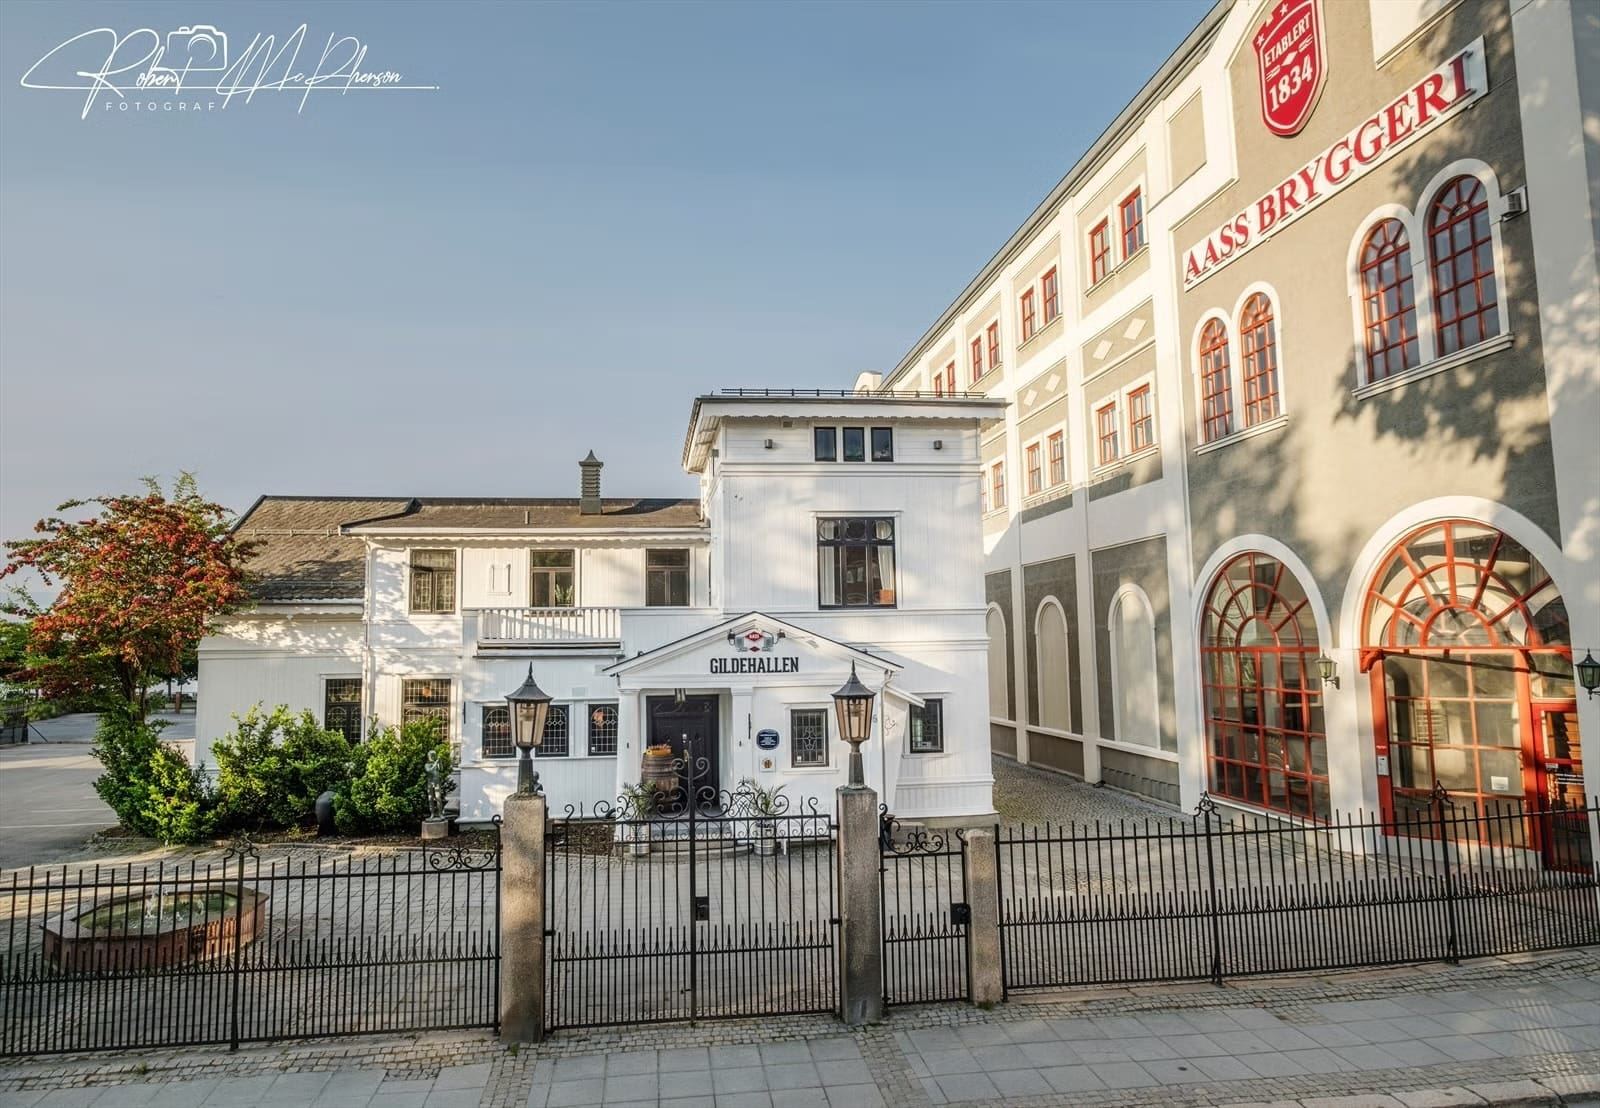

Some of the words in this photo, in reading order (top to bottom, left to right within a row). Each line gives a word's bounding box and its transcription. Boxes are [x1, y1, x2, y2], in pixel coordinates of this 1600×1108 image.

[1264, 11, 1311, 68] ETABLERT
[1269, 54, 1314, 113] 1834
[1184, 212, 1250, 285] AASS
[1256, 50, 1474, 234] BRYGGERI
[710, 656, 799, 674] GILDEHALLEN
